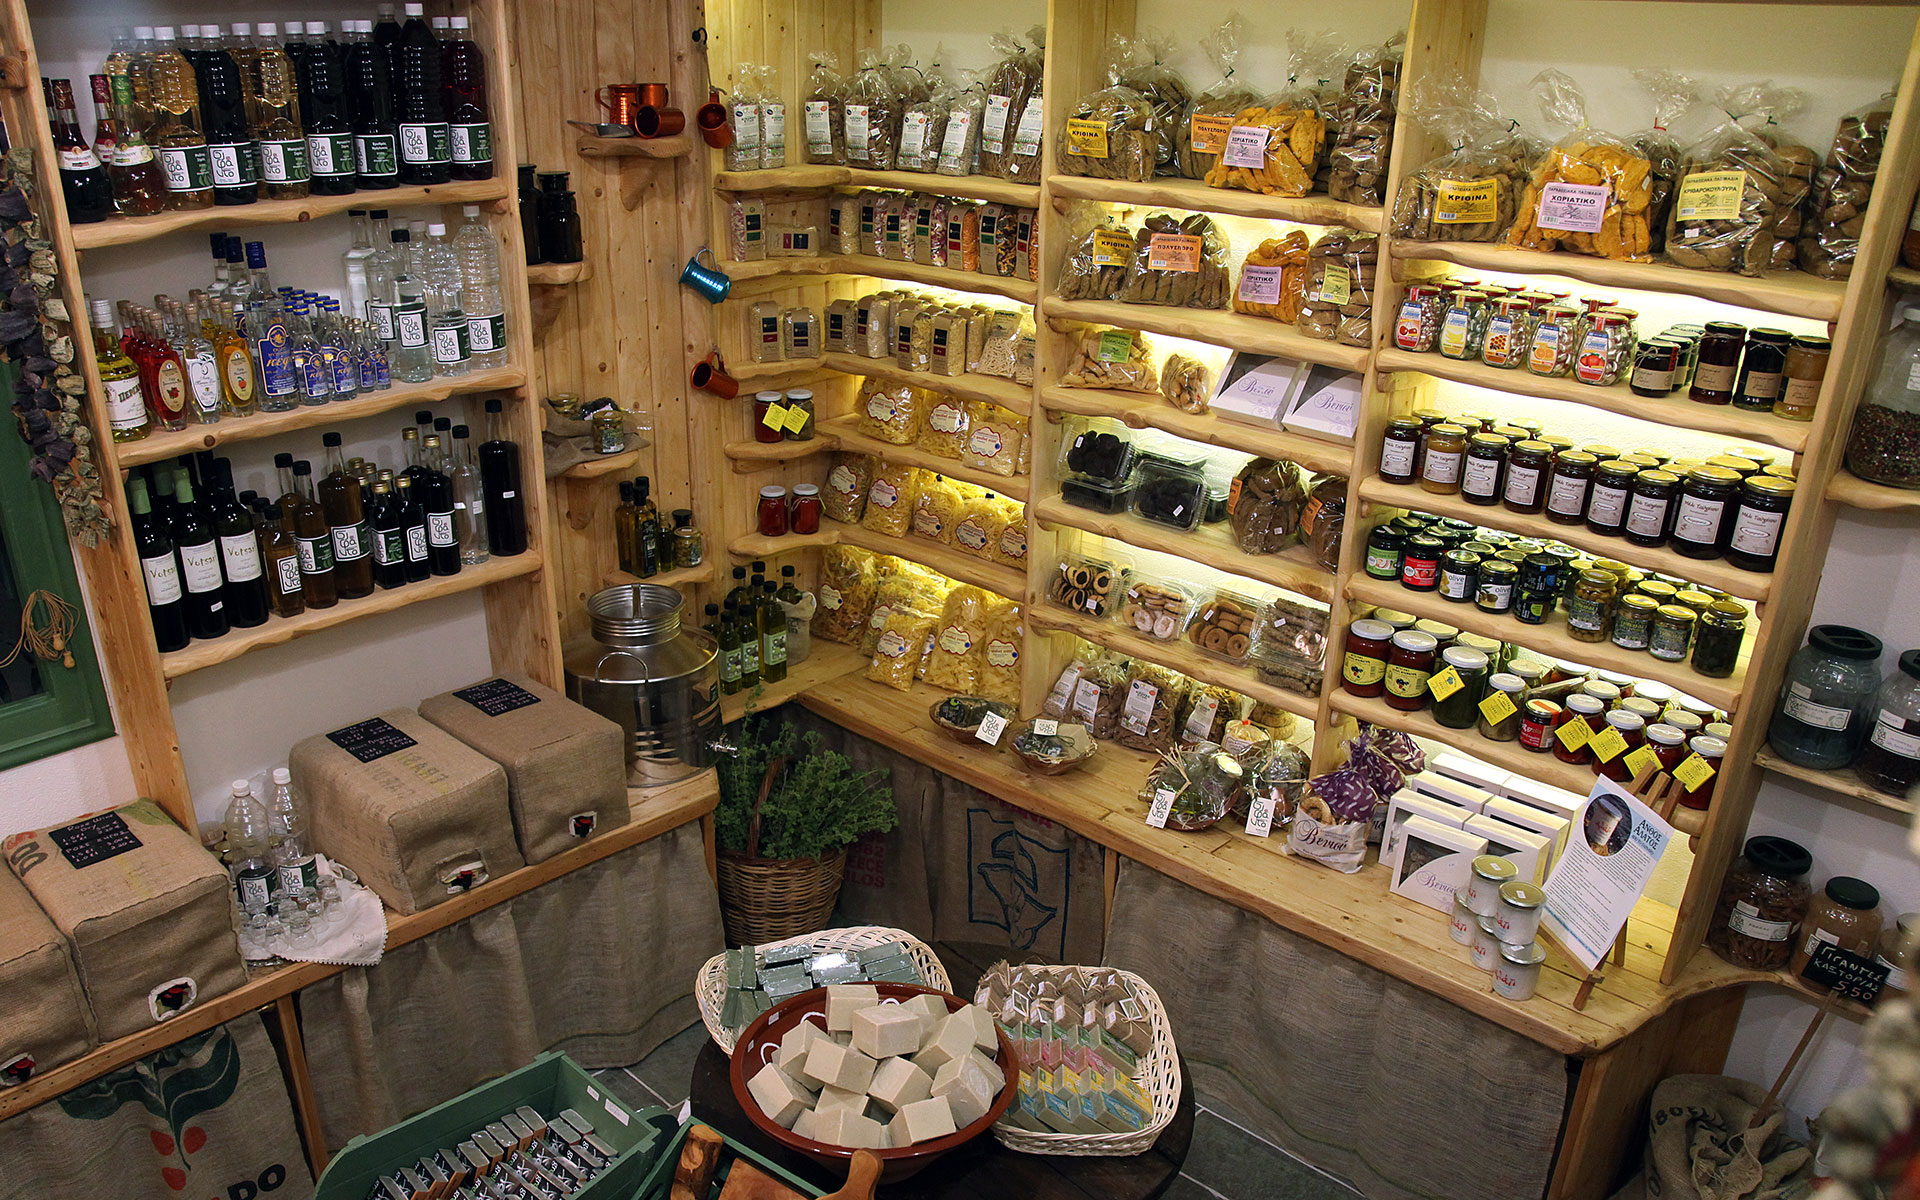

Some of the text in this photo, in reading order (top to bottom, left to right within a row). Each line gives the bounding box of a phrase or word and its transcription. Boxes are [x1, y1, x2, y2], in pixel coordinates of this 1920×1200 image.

[1072, 130, 1099, 138] ΚΡΙΘΙΝΑ
[1448, 194, 1488, 202] ΚΡΙΘΙΝΑ
[1551, 195, 1596, 205] ΧΩΡΙΑΤΙΚΟ
[1101, 240, 1130, 249] ΚΡΙΘΙΝΑ
[1449, 574, 1465, 583] olive
[1495, 585, 1511, 593] olive
[1633, 827, 1659, 851] ΑΛΑΤΟΣ
[1820, 945, 1884, 982] ΓΙΓΑΝΤΕΣ
[1832, 980, 1873, 1001] 5,50
